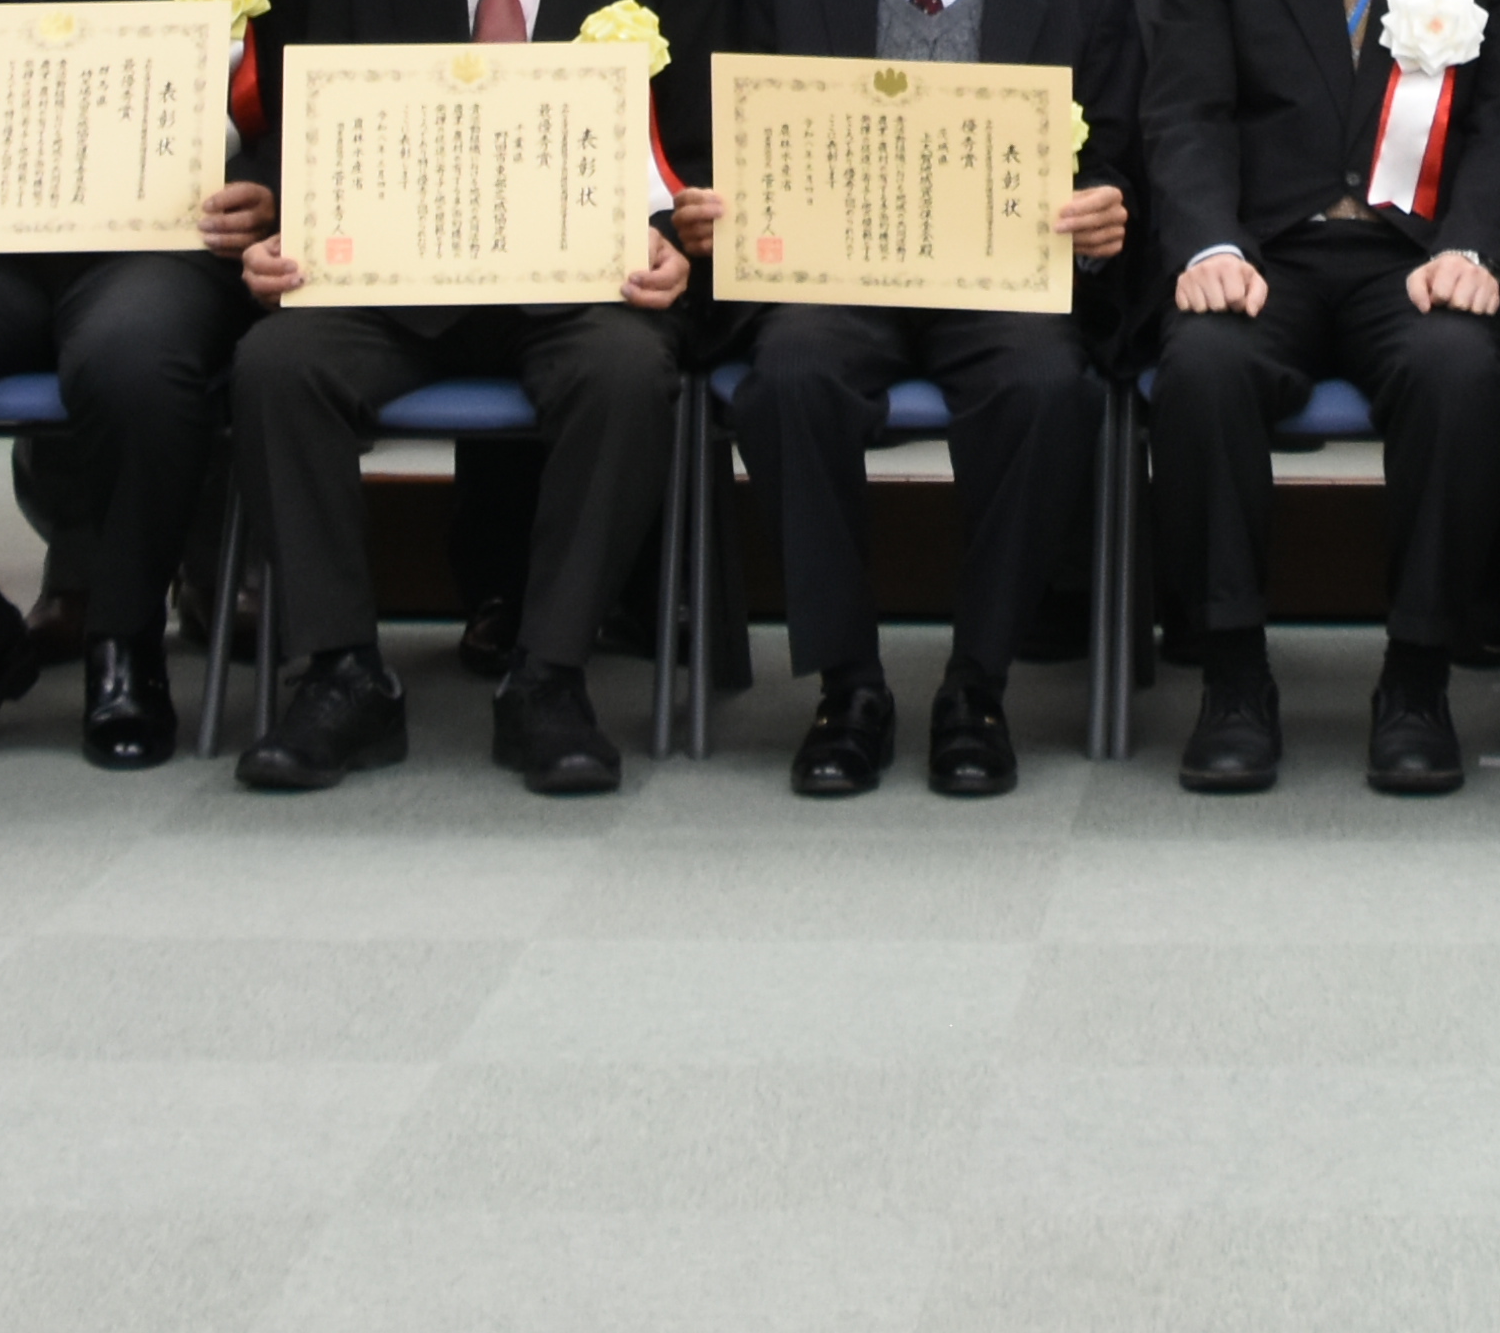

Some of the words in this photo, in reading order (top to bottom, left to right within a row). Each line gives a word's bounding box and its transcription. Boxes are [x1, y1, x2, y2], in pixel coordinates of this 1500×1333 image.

[156, 81, 177, 157] 表彰状
[575, 128, 597, 207] 表彰状
[1001, 144, 1022, 218] 表彰状
